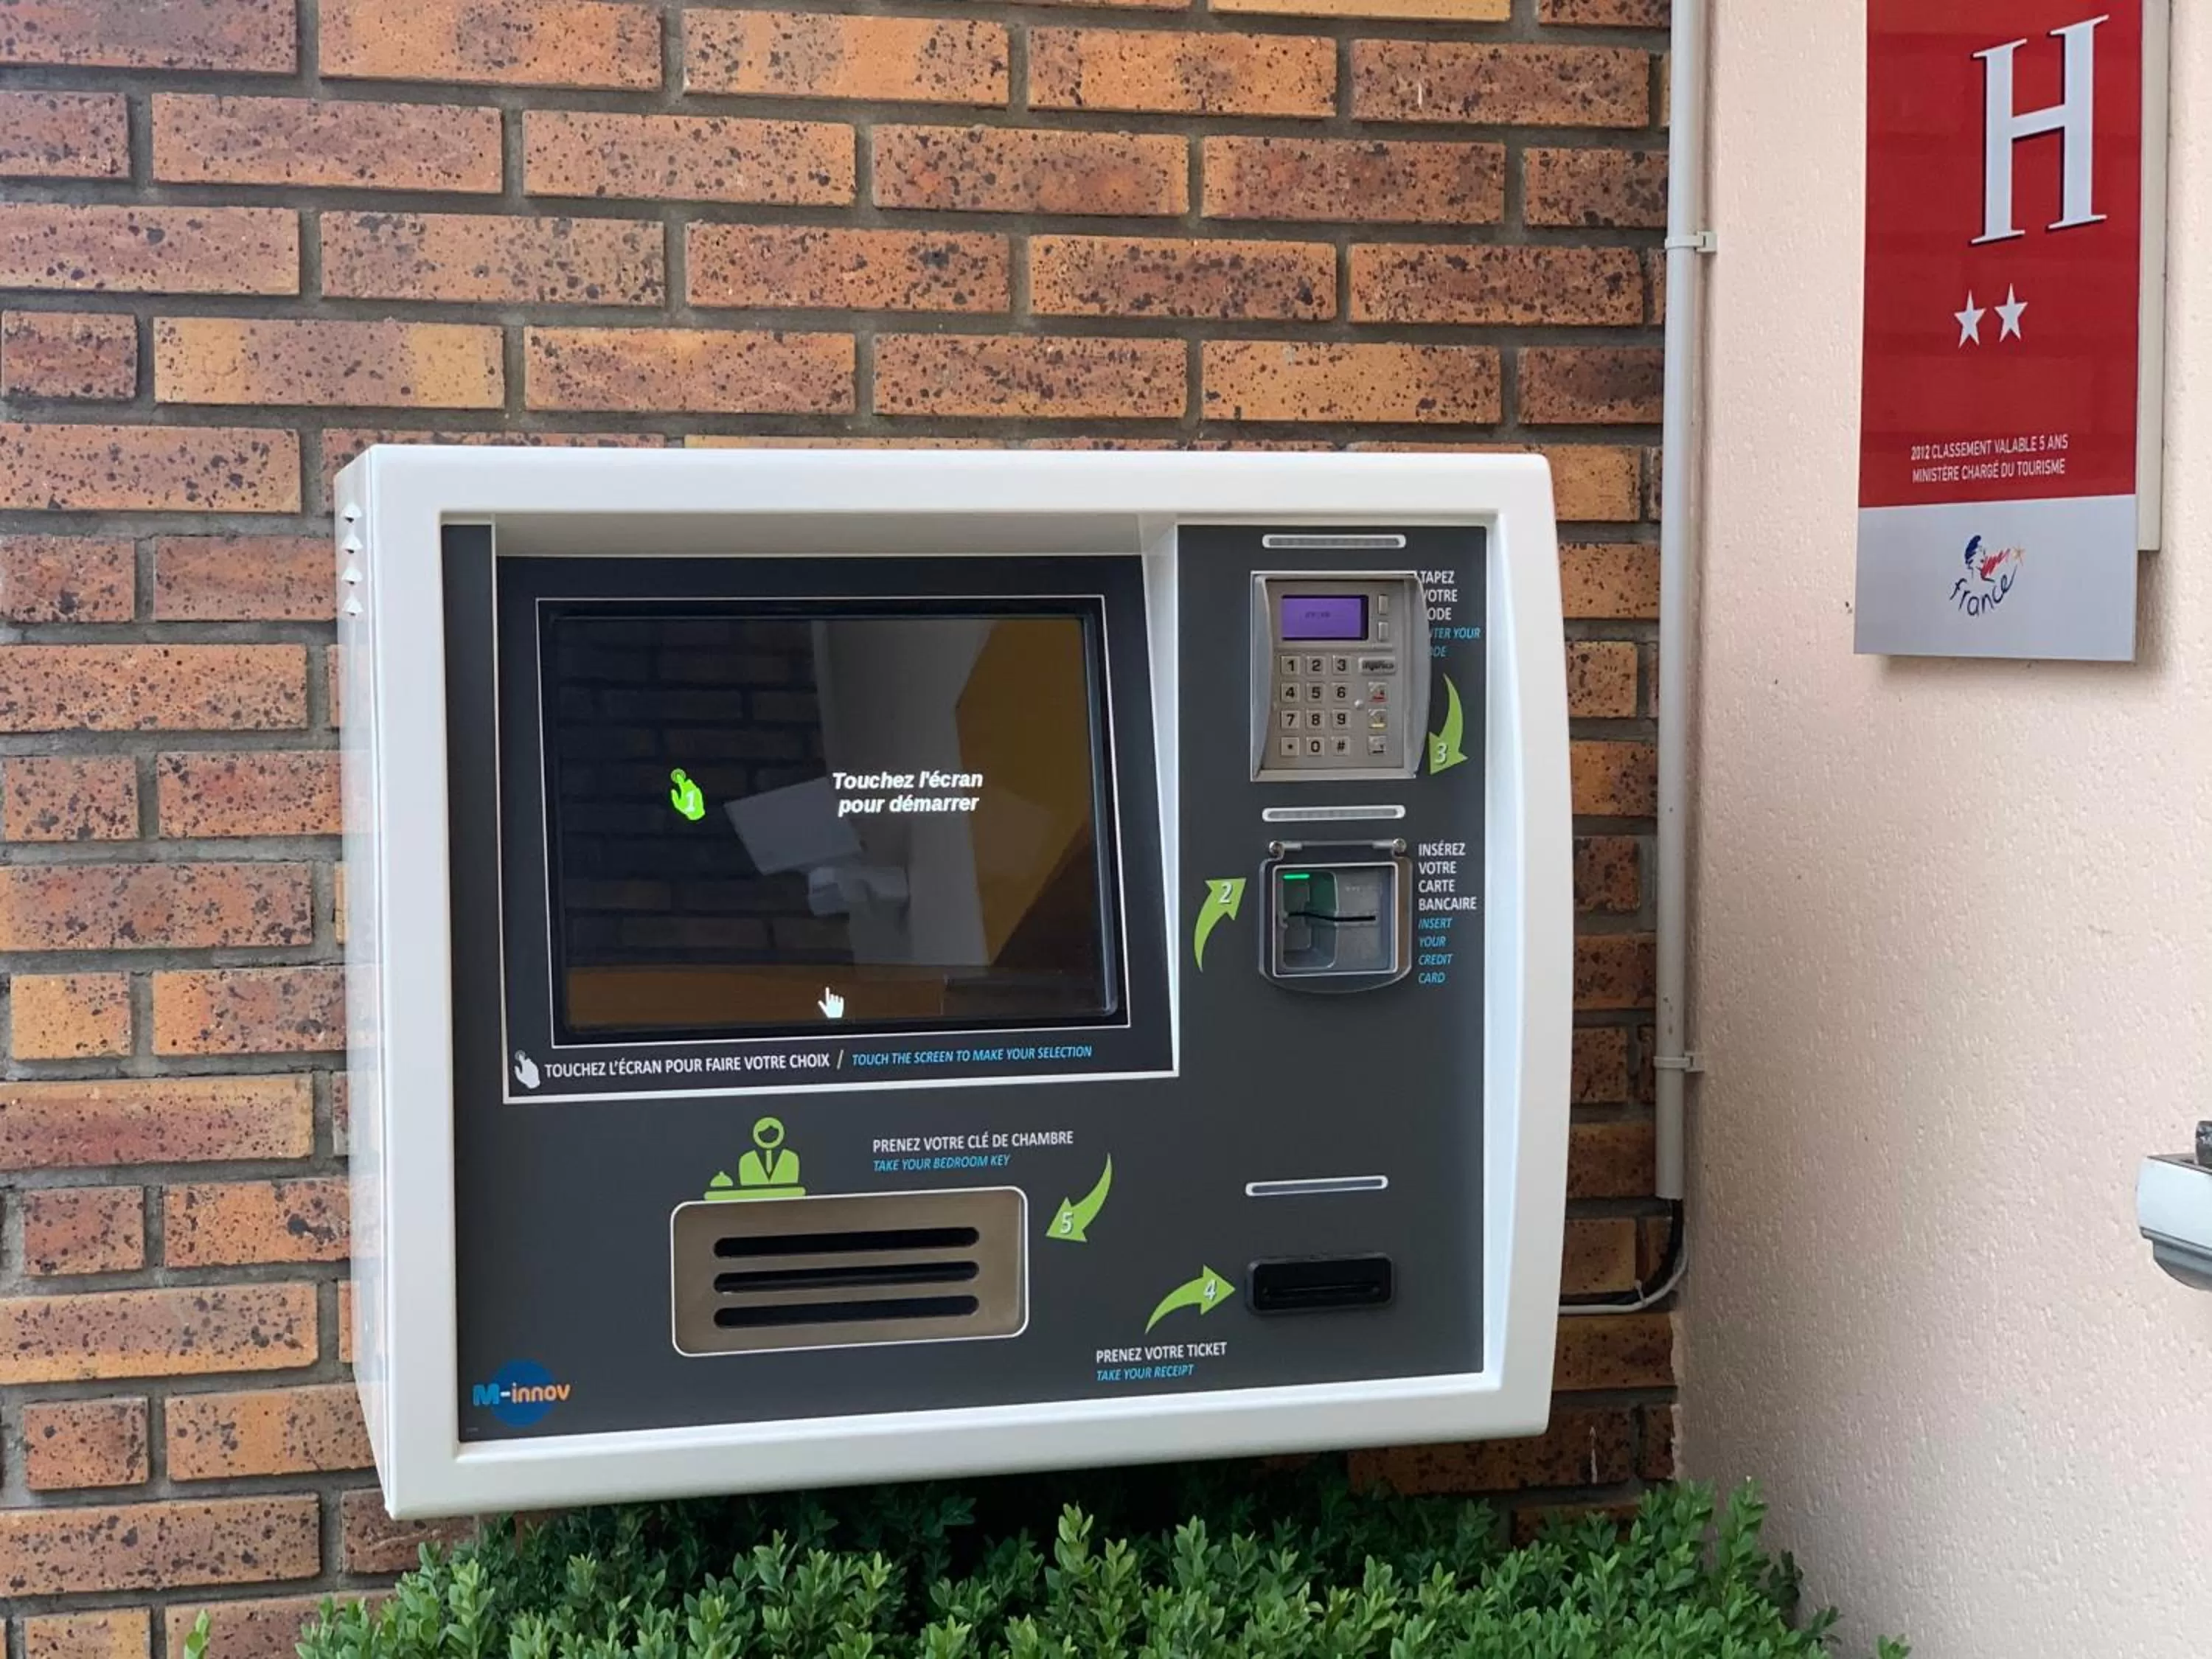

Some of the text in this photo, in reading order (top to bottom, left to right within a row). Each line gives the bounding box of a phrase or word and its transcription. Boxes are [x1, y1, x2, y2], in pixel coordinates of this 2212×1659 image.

[1972, 14, 2109, 244] H
[1911, 434, 2069, 461] 2012 CLASSEMENT VALABLE 5 ANS
[1961, 460, 1999, 480] CHARGÉ
[2000, 462, 2014, 479] DU
[2017, 458, 2066, 476] TOURISME
[1419, 570, 1455, 585] TAPEZ
[1427, 607, 1452, 621] ODE
[1430, 627, 1481, 639] TER YOUR
[1430, 645, 1447, 657] DE
[1287, 660, 1295, 672] 1
[1312, 659, 1322, 672] 2
[1337, 658, 1347, 672] 3
[1285, 686, 1346, 698] 4 5 6
[1286, 713, 1346, 726] 7 8 9
[1337, 740, 1346, 752] #
[1436, 743, 1447, 762] 3
[832, 770, 984, 790] Touchez l'écran
[686, 792, 695, 812] 1
[838, 793, 980, 818] pour démarrer
[1419, 841, 1467, 857] INSÉREZ
[1419, 860, 1457, 875] VOTRE
[1219, 880, 1232, 904] 2
[1419, 879, 1455, 894] CARTE
[1419, 896, 1478, 911] BANCAIRE
[1419, 917, 1453, 930] INSERT
[1419, 936, 1447, 947] YOUR
[1419, 953, 1453, 965] CREDIT
[1419, 972, 1446, 984] CARD
[544, 1060, 606, 1079] TOUCHEZ
[666, 1058, 703, 1074] POUR
[706, 1055, 741, 1071] FAIRE
[744, 1054, 787, 1071] VOTRE
[790, 1053, 830, 1069] CHOIX
[852, 1052, 889, 1066] TOUCH
[891, 1051, 912, 1065] THE
[914, 1049, 954, 1063] SCREEN
[956, 1050, 971, 1062] TO
[973, 1048, 1004, 1062] MAKE
[1006, 1047, 1035, 1060] YOUR
[1037, 1045, 1092, 1059] SELECTION
[872, 1130, 1074, 1153] PRENEZ VOTRE CLÉ DE CHAMBRE
[873, 1153, 1011, 1172] TAKE YOUR BEDROOM KEY
[1060, 1211, 1073, 1234] 5
[1203, 1280, 1217, 1299] 4
[1096, 1341, 1228, 1363] PRENEZ VOTRE TICKET
[1096, 1363, 1194, 1381] TAKE YOUR RECEIPT
[473, 1382, 571, 1407] M-innov
